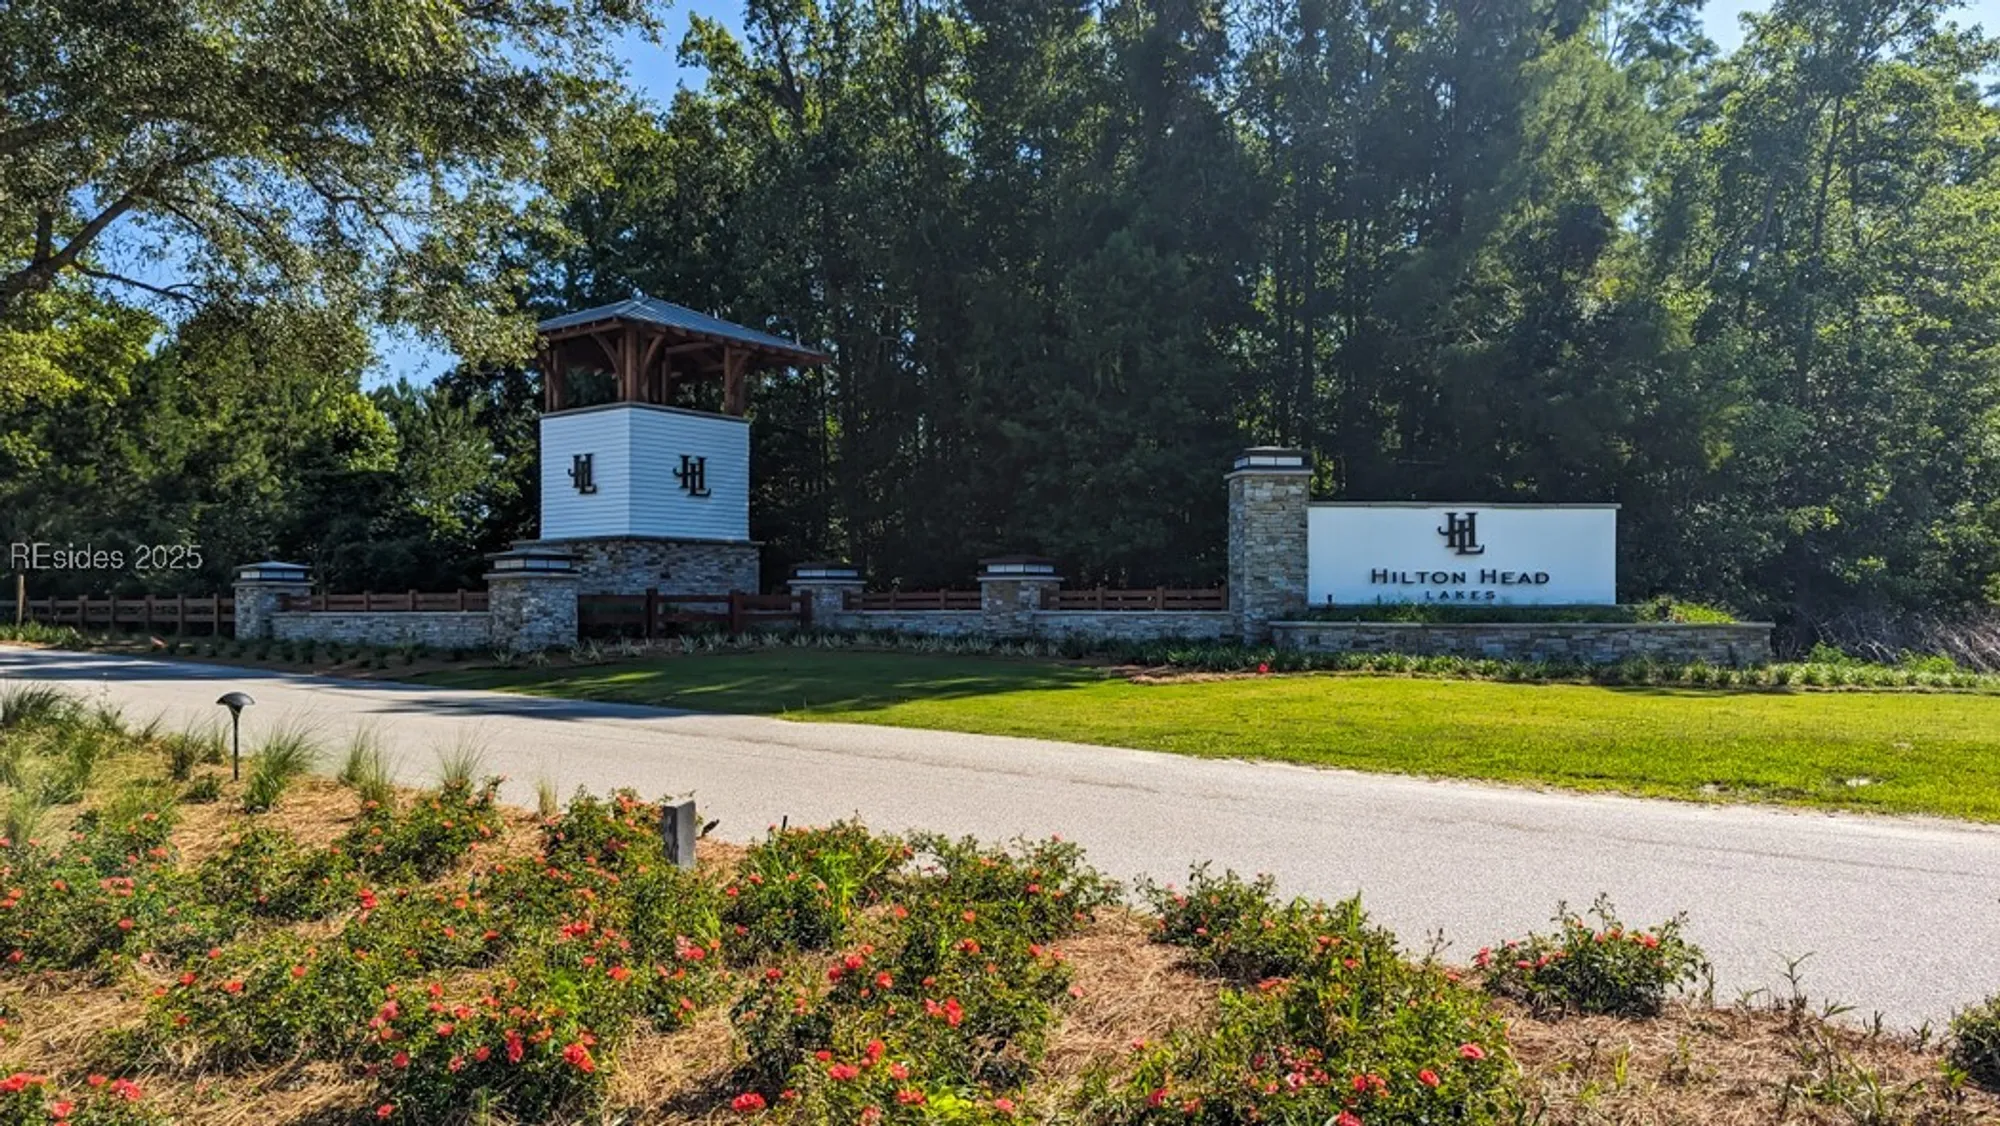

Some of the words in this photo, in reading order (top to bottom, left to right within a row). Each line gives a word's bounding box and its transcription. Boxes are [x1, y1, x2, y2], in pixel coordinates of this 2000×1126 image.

[1370, 568, 1466, 585] HILTON
[1480, 568, 1550, 585] HEAD
[1425, 590, 1496, 600] LAKES
